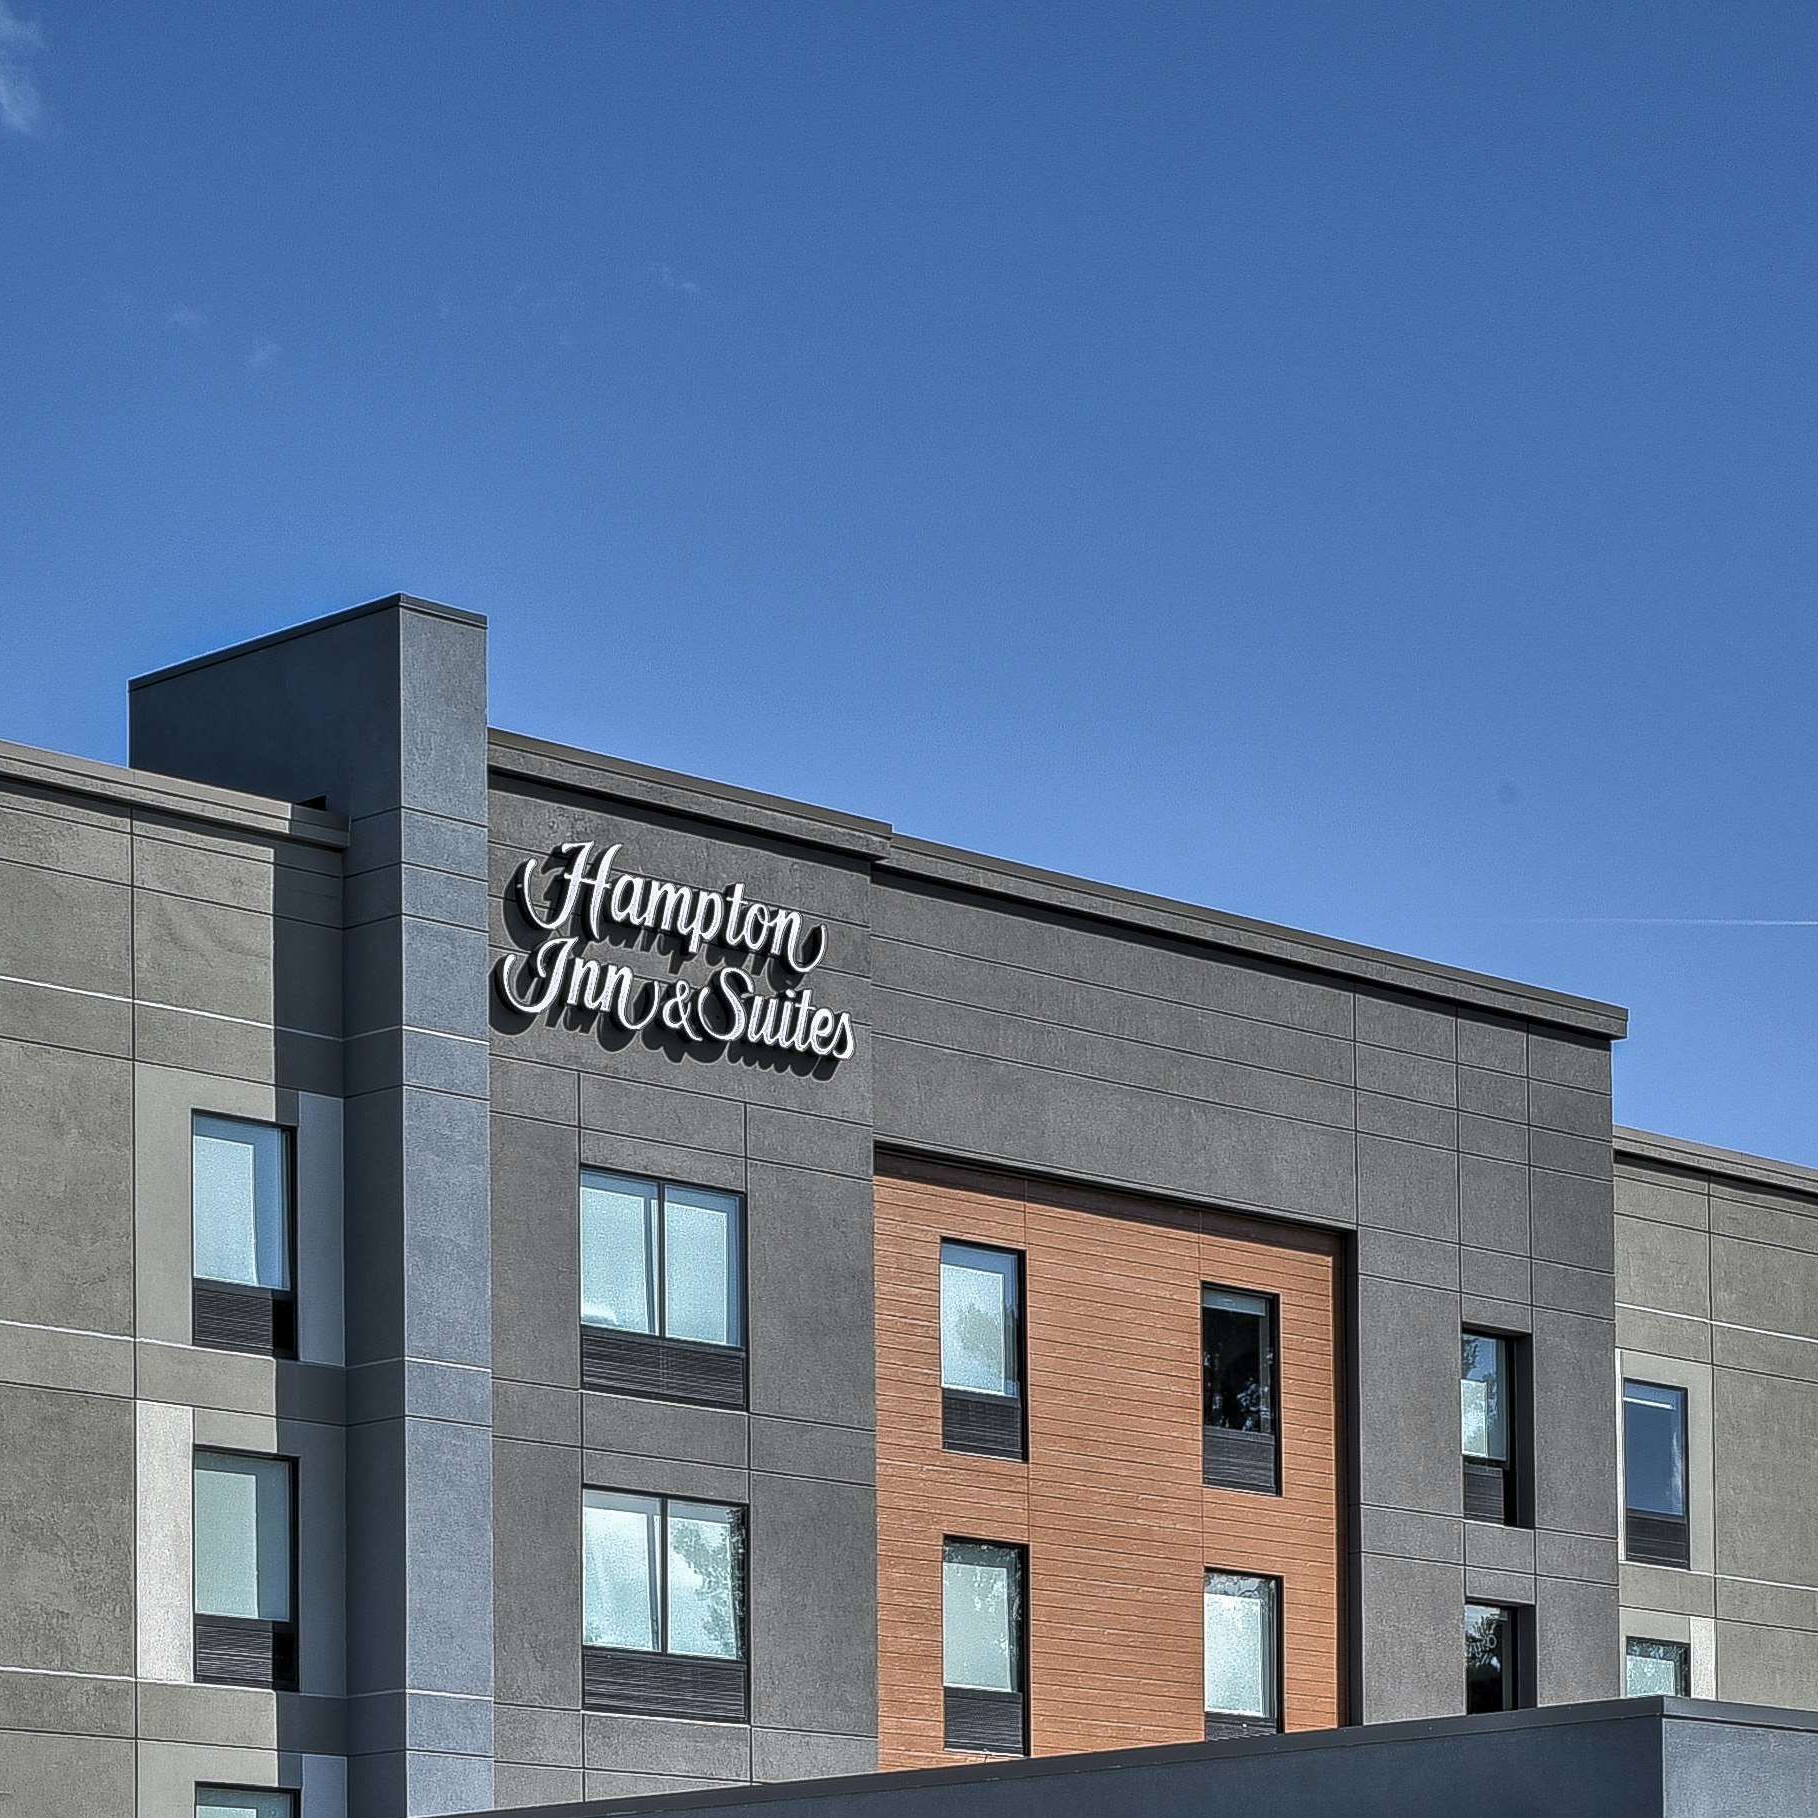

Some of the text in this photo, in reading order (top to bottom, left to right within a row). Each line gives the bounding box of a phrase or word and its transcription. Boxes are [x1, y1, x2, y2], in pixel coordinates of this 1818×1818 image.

[524, 841, 827, 973] Hampton
[502, 937, 855, 1060] Inn & Suites
